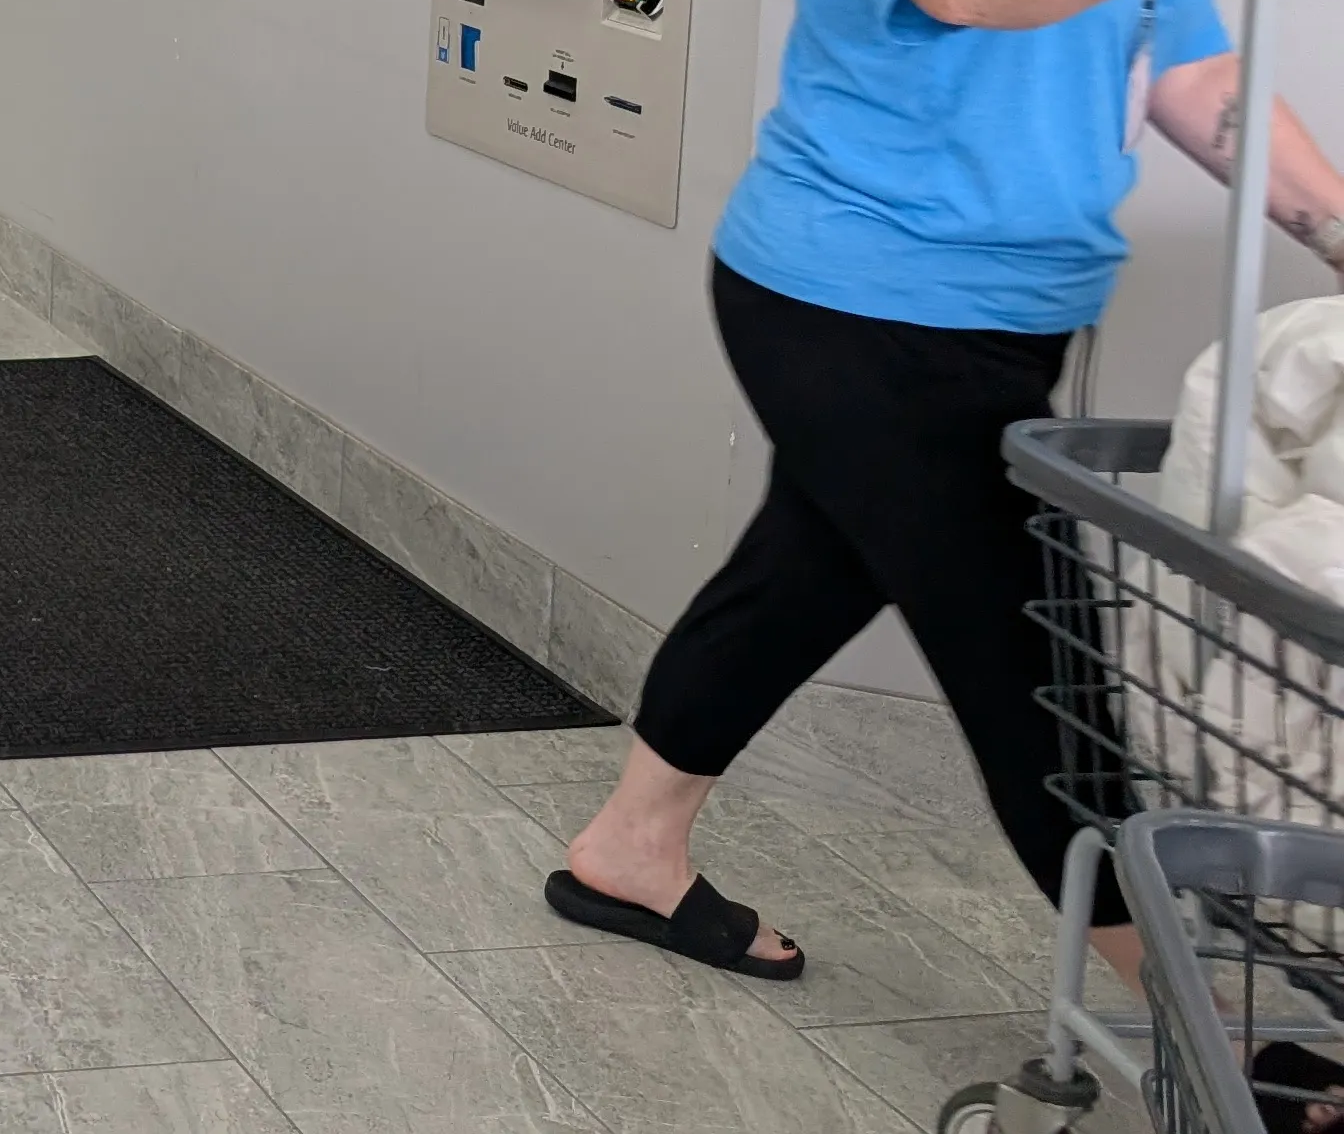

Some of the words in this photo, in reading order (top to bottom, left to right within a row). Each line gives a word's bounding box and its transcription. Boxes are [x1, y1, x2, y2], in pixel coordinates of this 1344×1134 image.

[507, 118, 529, 137] Value
[530, 126, 546, 144] Add
[548, 132, 576, 154] Center
